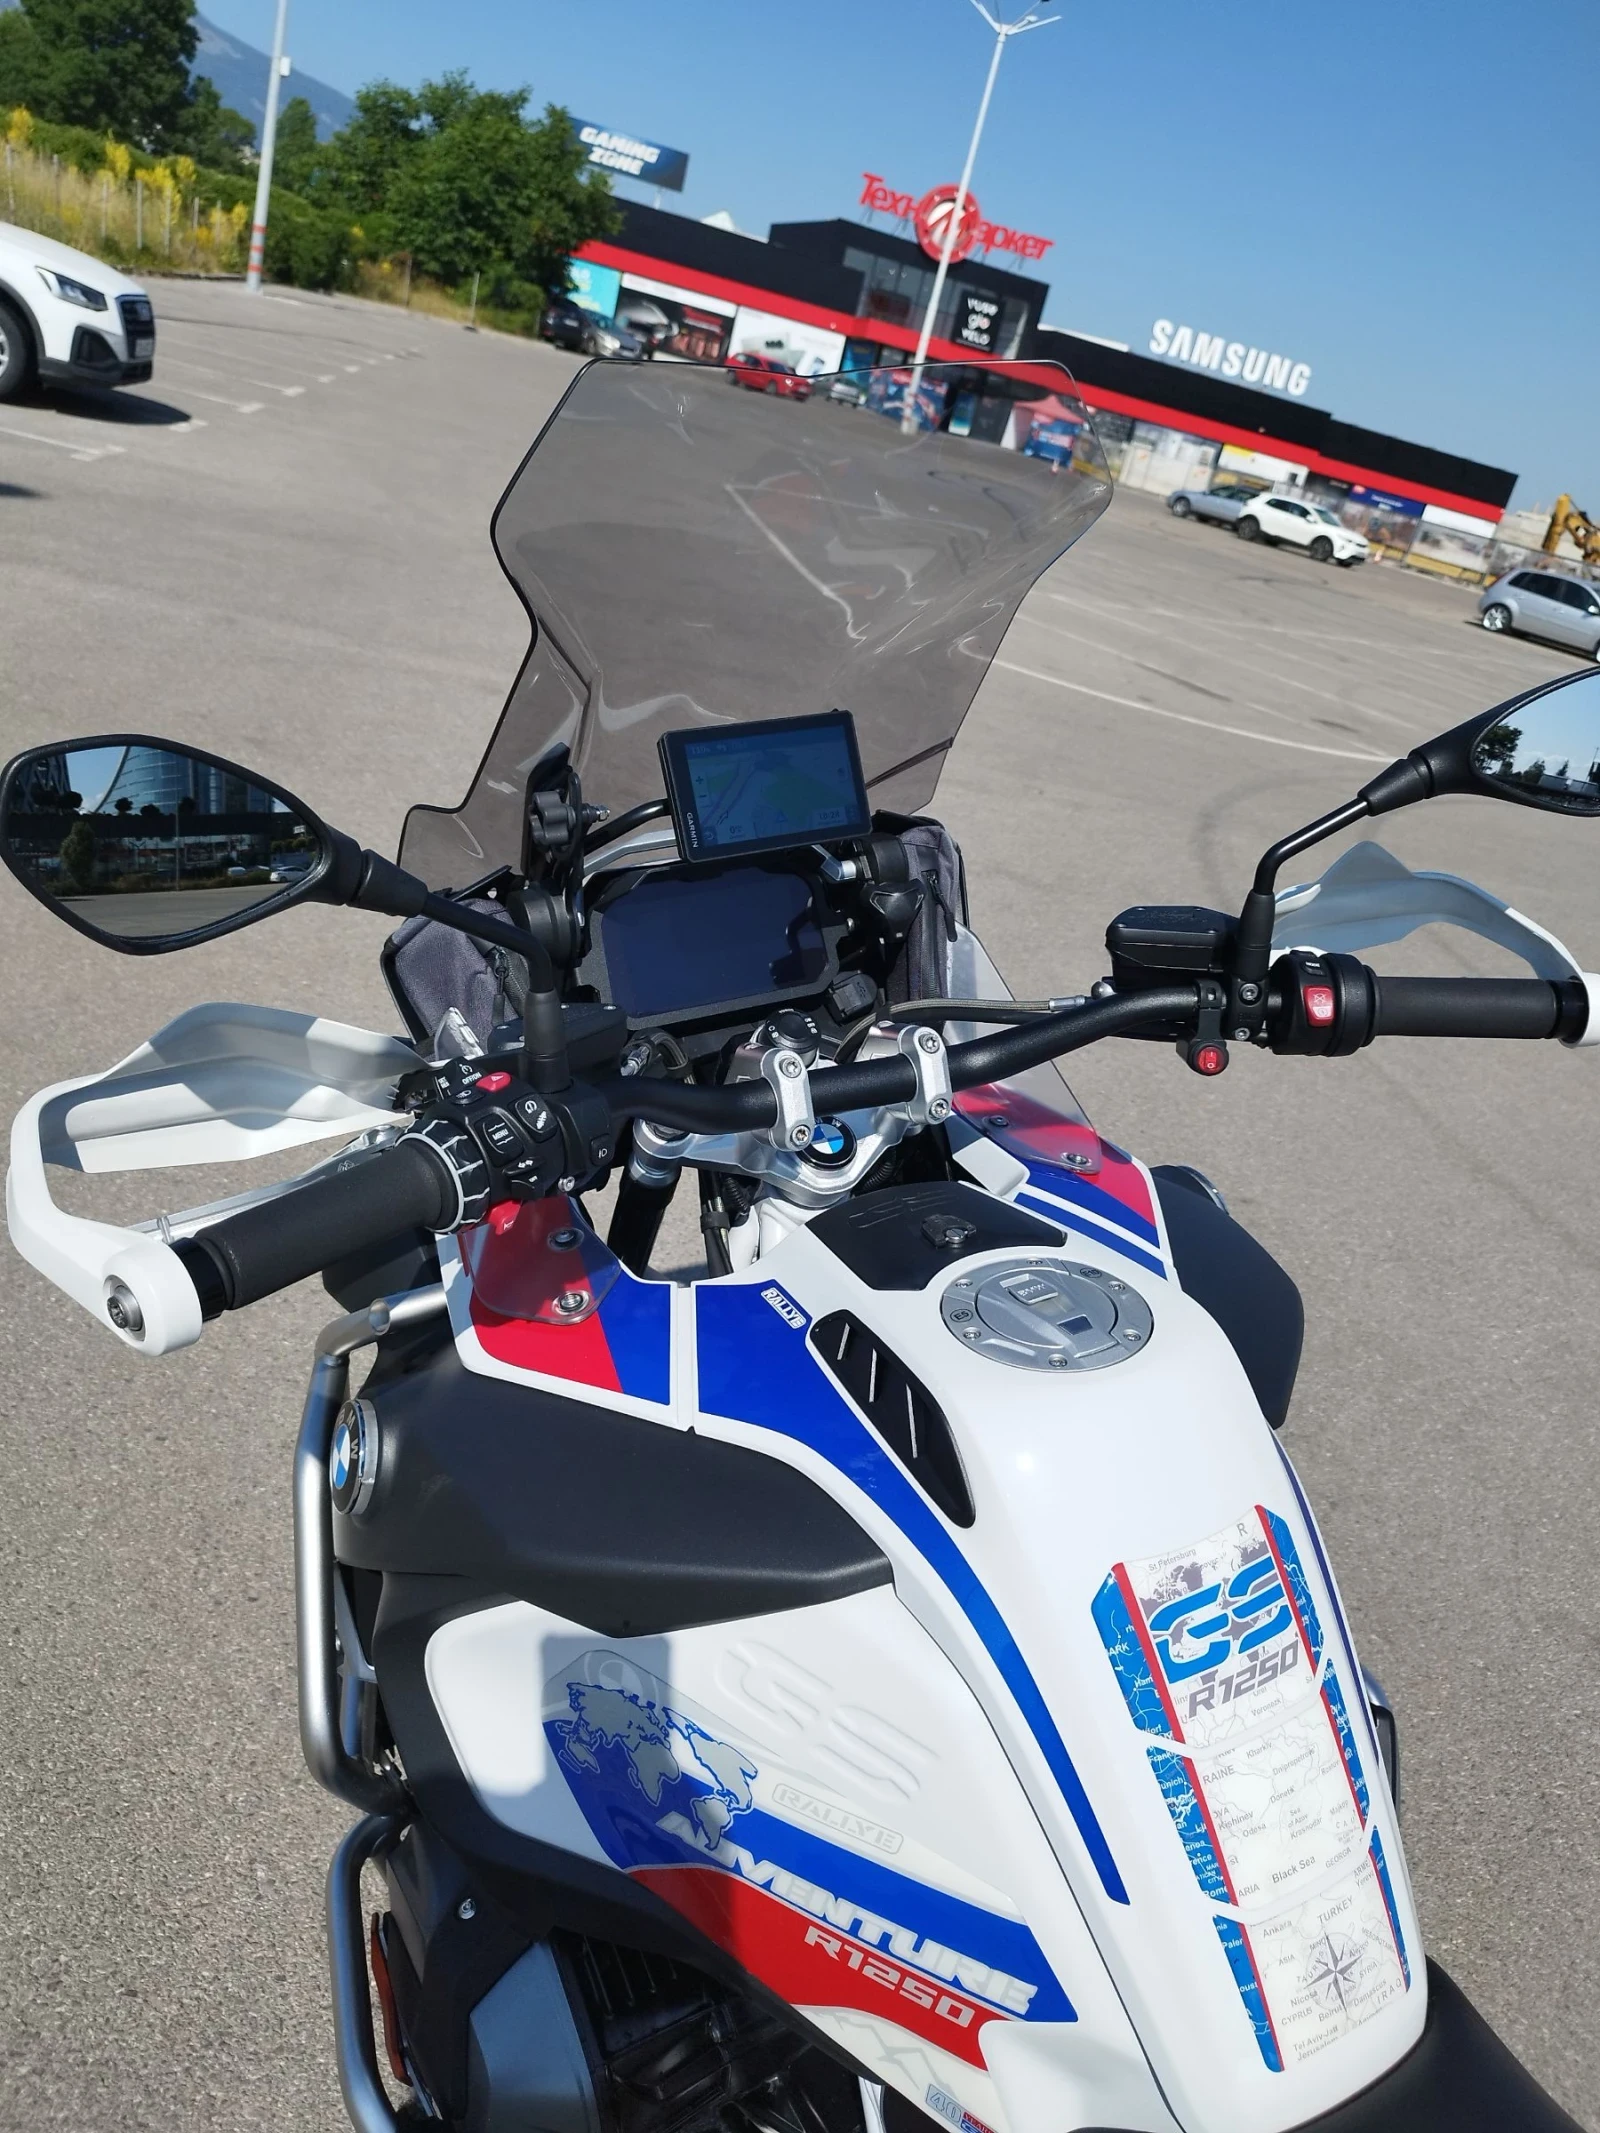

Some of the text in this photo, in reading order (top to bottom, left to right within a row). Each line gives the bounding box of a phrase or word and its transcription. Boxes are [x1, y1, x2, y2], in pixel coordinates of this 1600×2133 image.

[579, 127, 660, 164] GAMING
[588, 146, 645, 175] ZONE
[1149, 319, 1312, 396] SAMSUNG
[686, 811, 700, 849] GARMIN
[491, 1128, 509, 1141] MENU
[763, 1289, 804, 1327] RALLYE
[1149, 1555, 1294, 1684] GS
[1188, 1638, 1299, 1719] R1250
[780, 1787, 897, 1850] RALLYE
[1271, 1855, 1316, 1884] Black Sea
[1317, 1895, 1354, 1925] TURKEY
[804, 1925, 976, 2029] R1250
[1281, 2006, 1313, 2027] CYPRUS
[930, 2091, 962, 2123] 40
